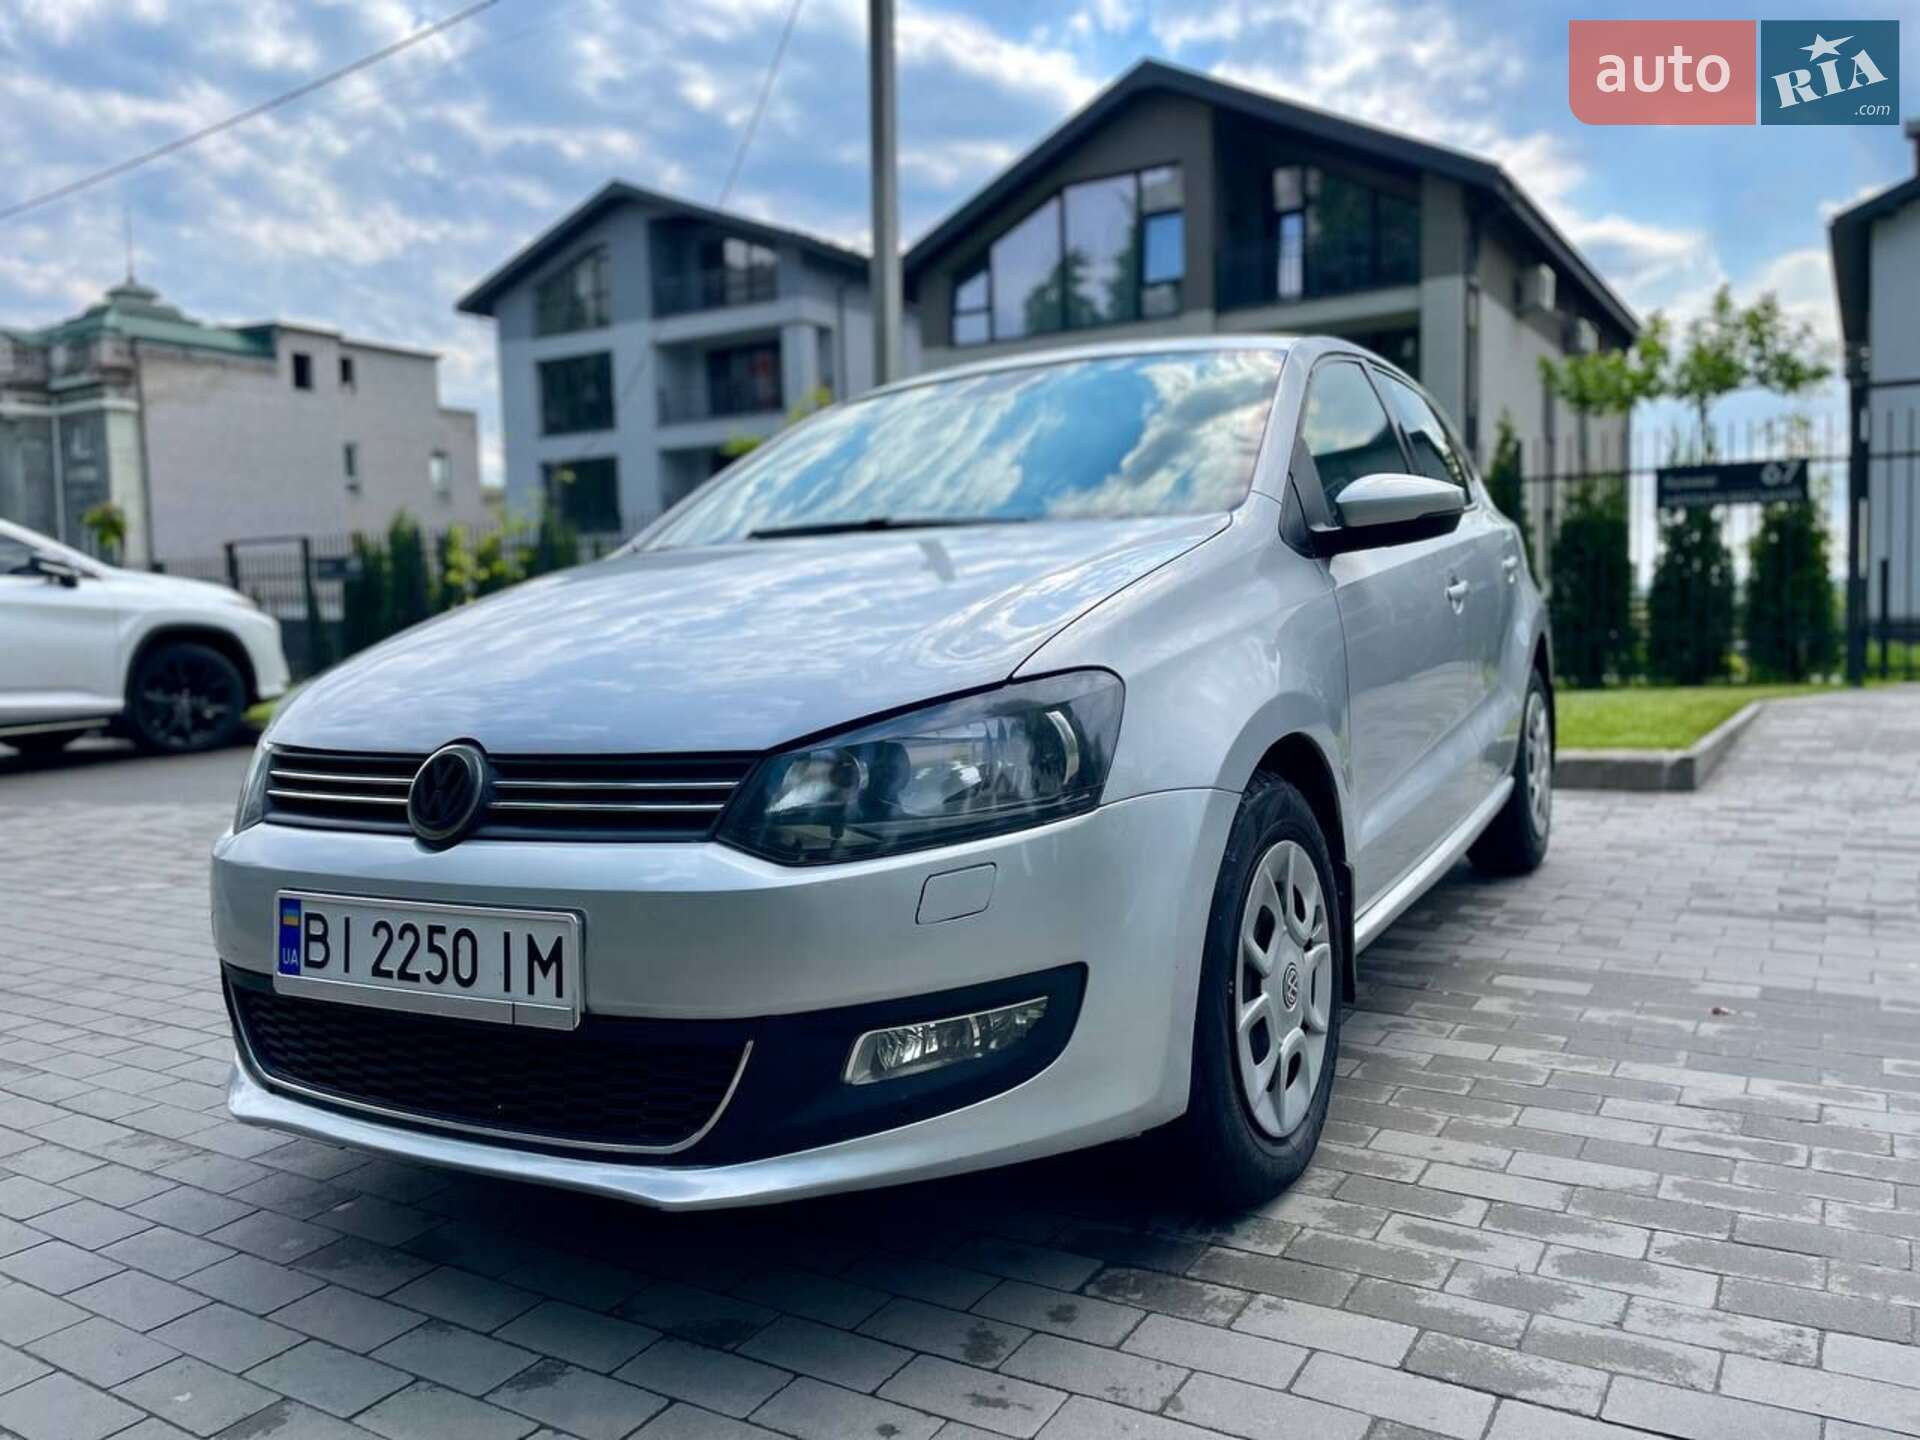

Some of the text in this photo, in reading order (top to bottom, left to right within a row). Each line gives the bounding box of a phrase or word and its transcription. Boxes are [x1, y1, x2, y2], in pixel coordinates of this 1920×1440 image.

[282, 947, 299, 966] UA
[304, 912, 564, 998] BI 2250 IM
